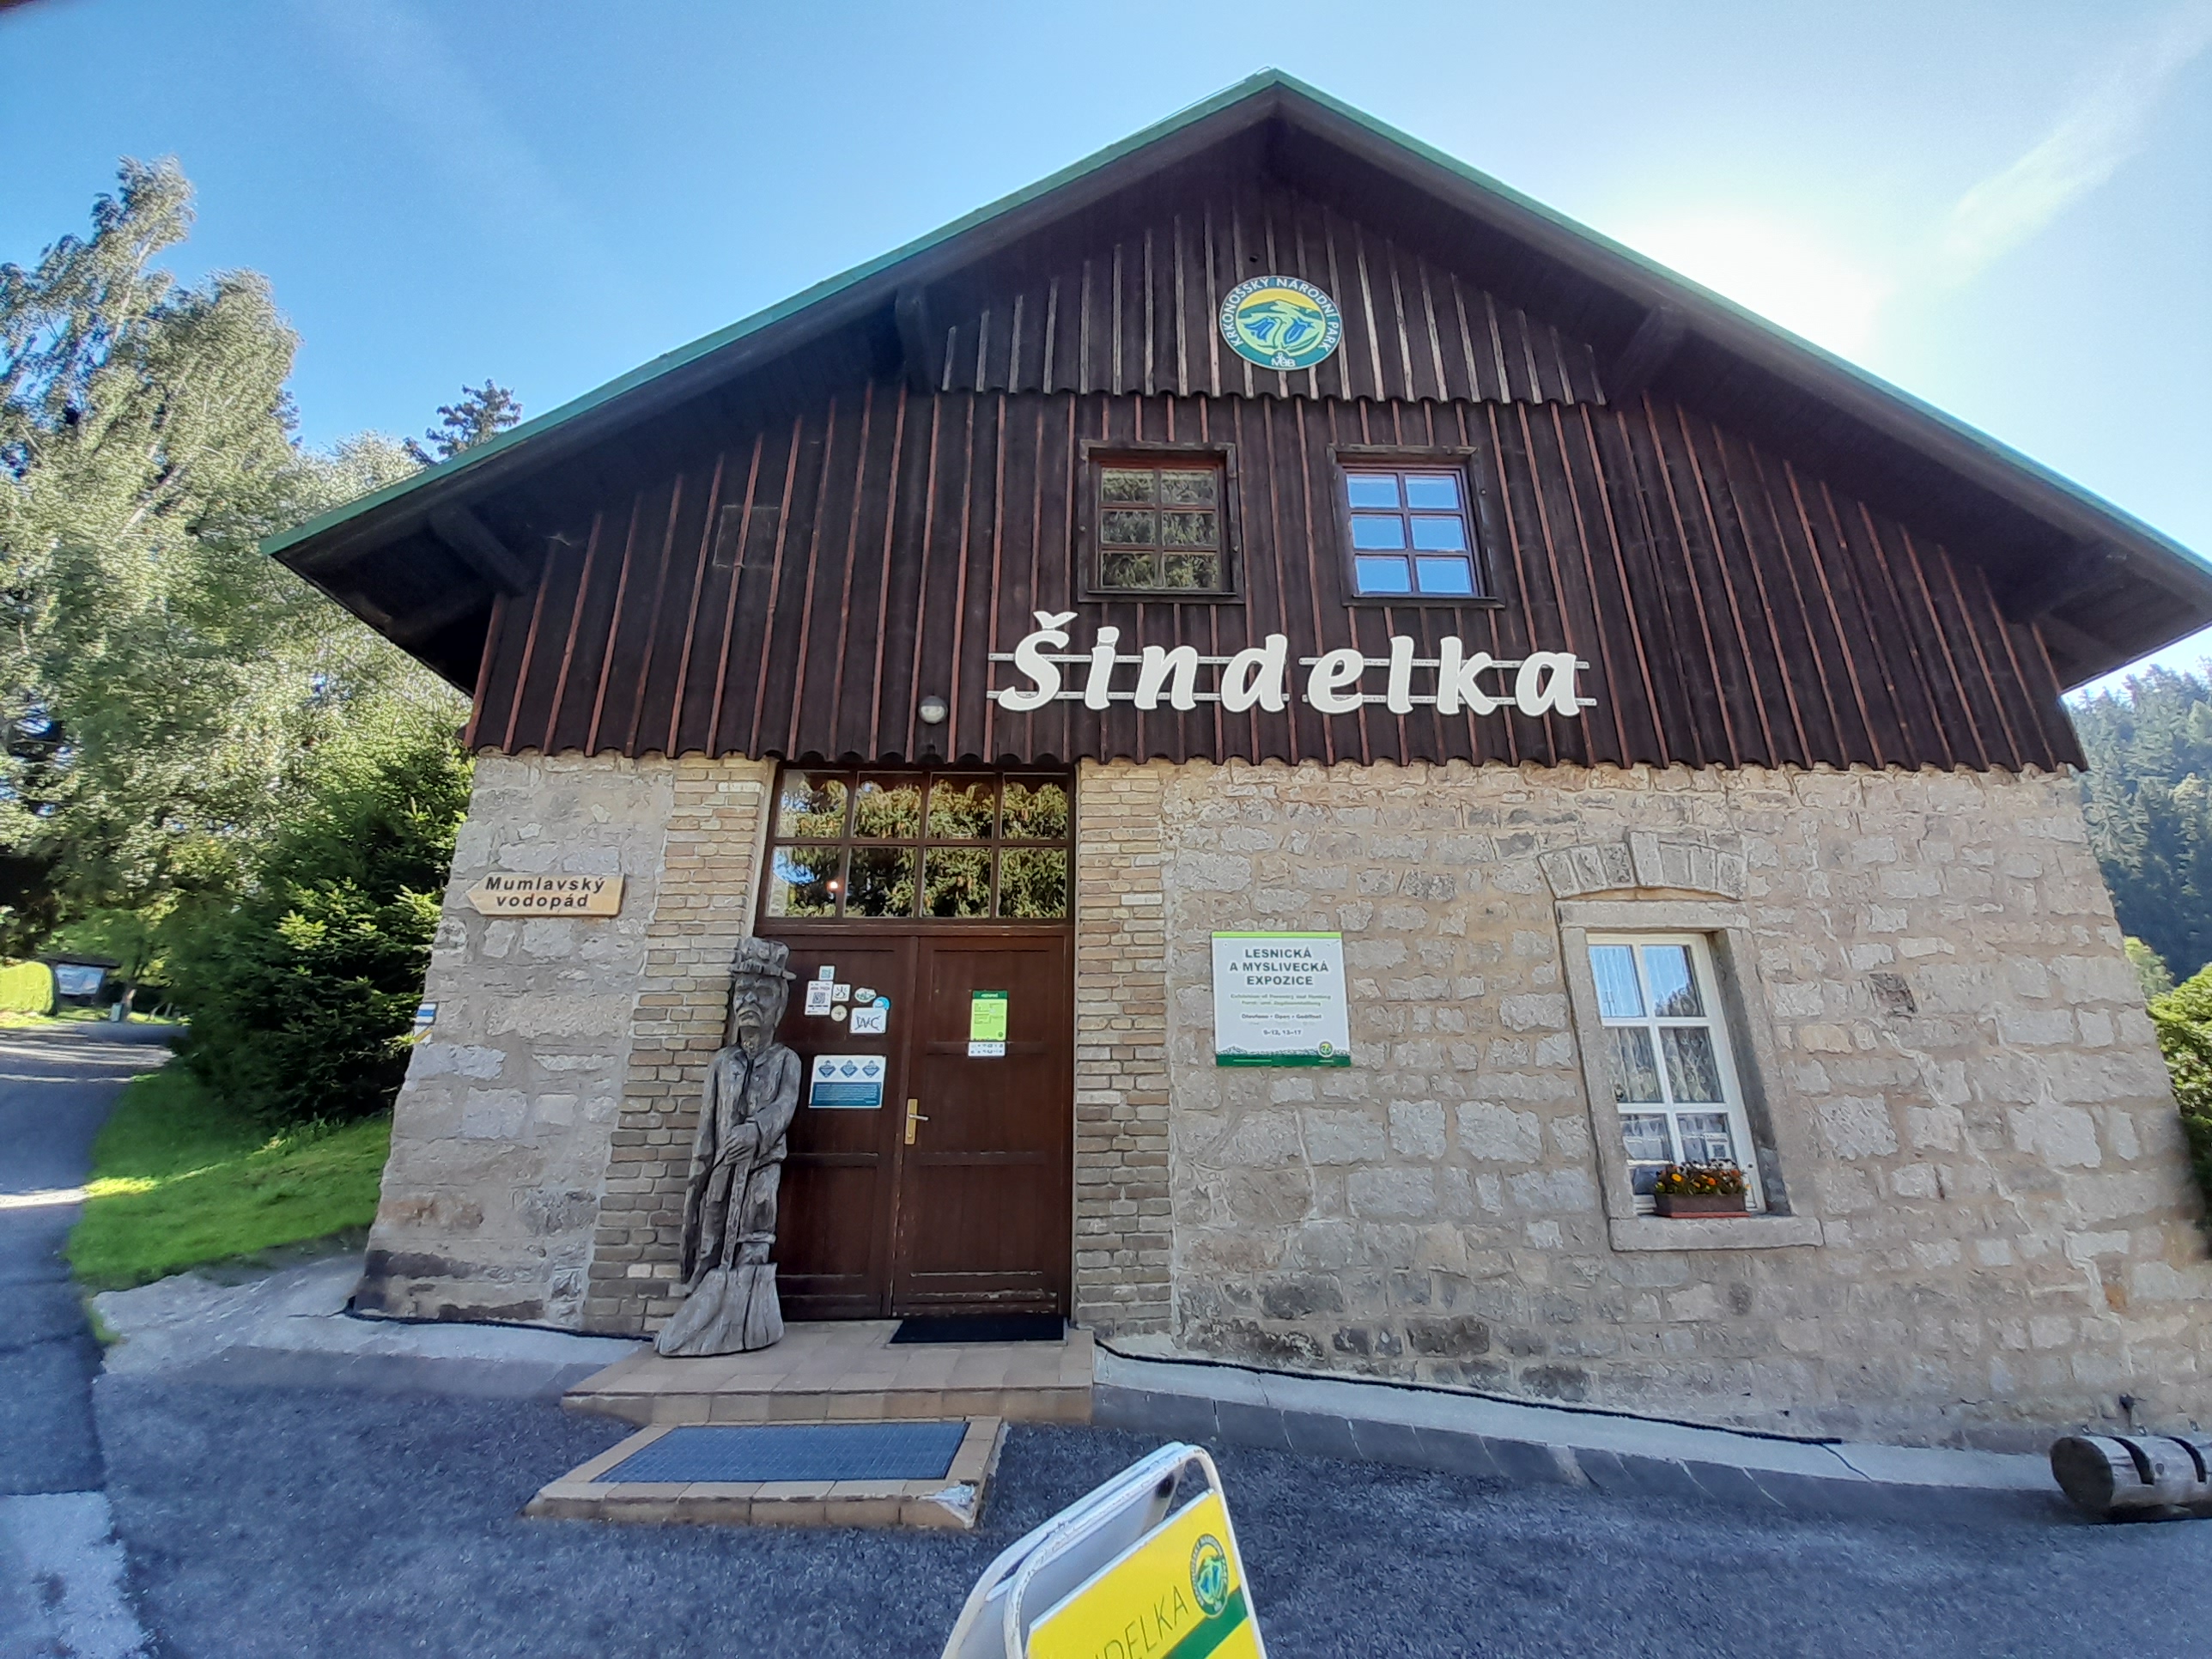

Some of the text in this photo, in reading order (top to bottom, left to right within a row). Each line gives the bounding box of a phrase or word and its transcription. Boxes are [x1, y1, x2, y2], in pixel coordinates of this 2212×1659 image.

[1222, 276, 1340, 352] KRKONOŠSKÝ NÁRODNÍ PARK
[998, 611, 1580, 716] Šindelka
[485, 876, 605, 894] Mumlavský
[496, 893, 589, 910] vodopád
[1245, 947, 1312, 958] LESNICKÁ
[1230, 961, 1329, 972] A MYSLIVECKÁ
[1247, 975, 1314, 986] EXPOZICE
